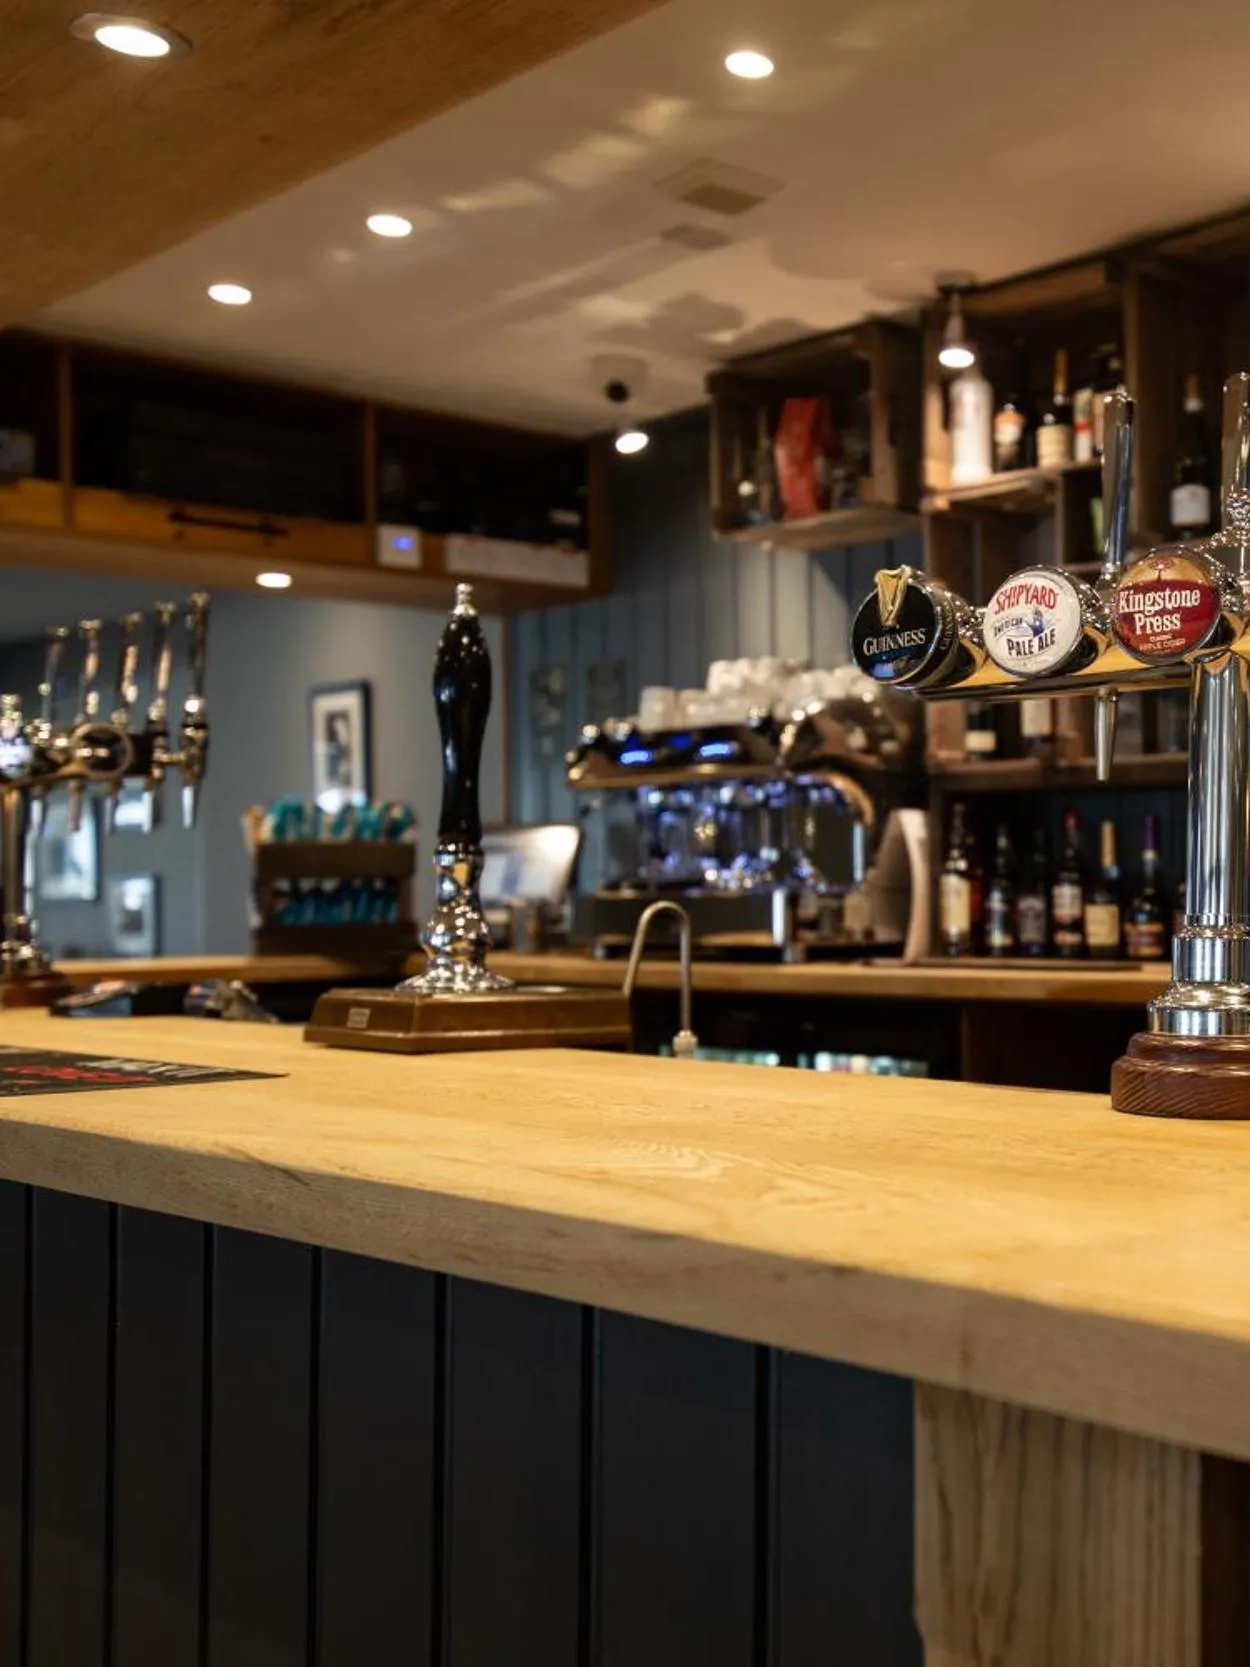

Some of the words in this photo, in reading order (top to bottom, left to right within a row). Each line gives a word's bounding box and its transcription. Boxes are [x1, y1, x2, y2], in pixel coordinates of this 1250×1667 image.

[994, 583, 1058, 616] SHIPYARD
[1119, 587, 1201, 615] Kingstone
[1133, 612, 1182, 635] Press
[863, 627, 927, 657] GUINNESS
[1006, 638, 1034, 657] PALE
[1038, 628, 1056, 652] ALE
